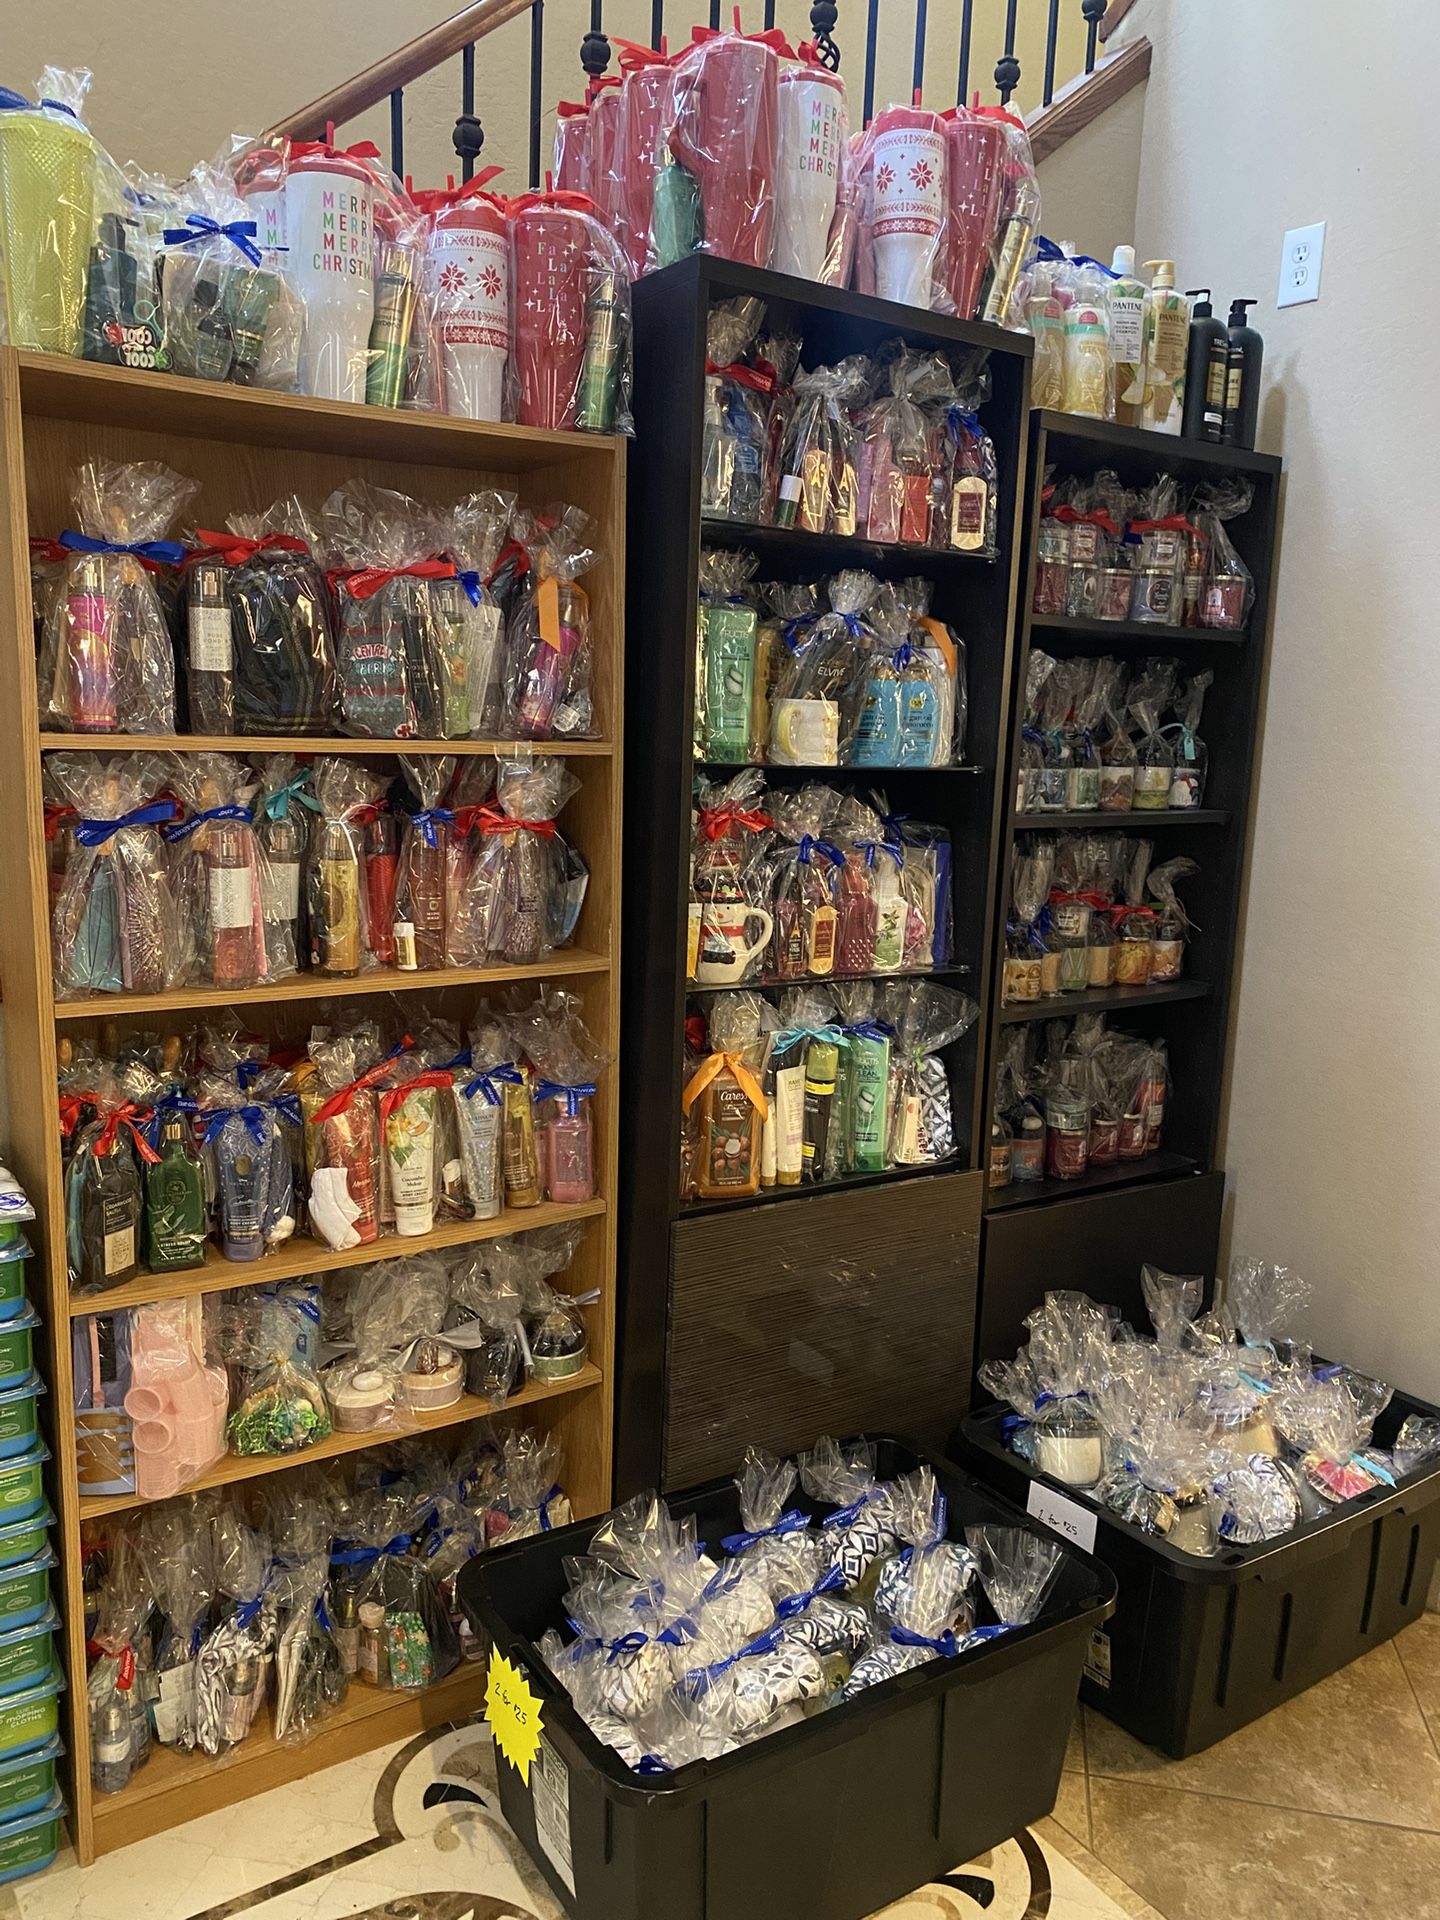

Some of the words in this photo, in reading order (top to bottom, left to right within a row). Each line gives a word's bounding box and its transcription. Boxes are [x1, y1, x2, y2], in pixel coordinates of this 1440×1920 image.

[799, 155, 836, 179] CHRIST
[322, 190, 368, 217] MERR
[323, 211, 368, 238] MERR
[537, 241, 556, 256] Fa
[548, 257, 568, 273] La
[537, 271, 556, 285] La
[494, 1682, 501, 1697] 2
